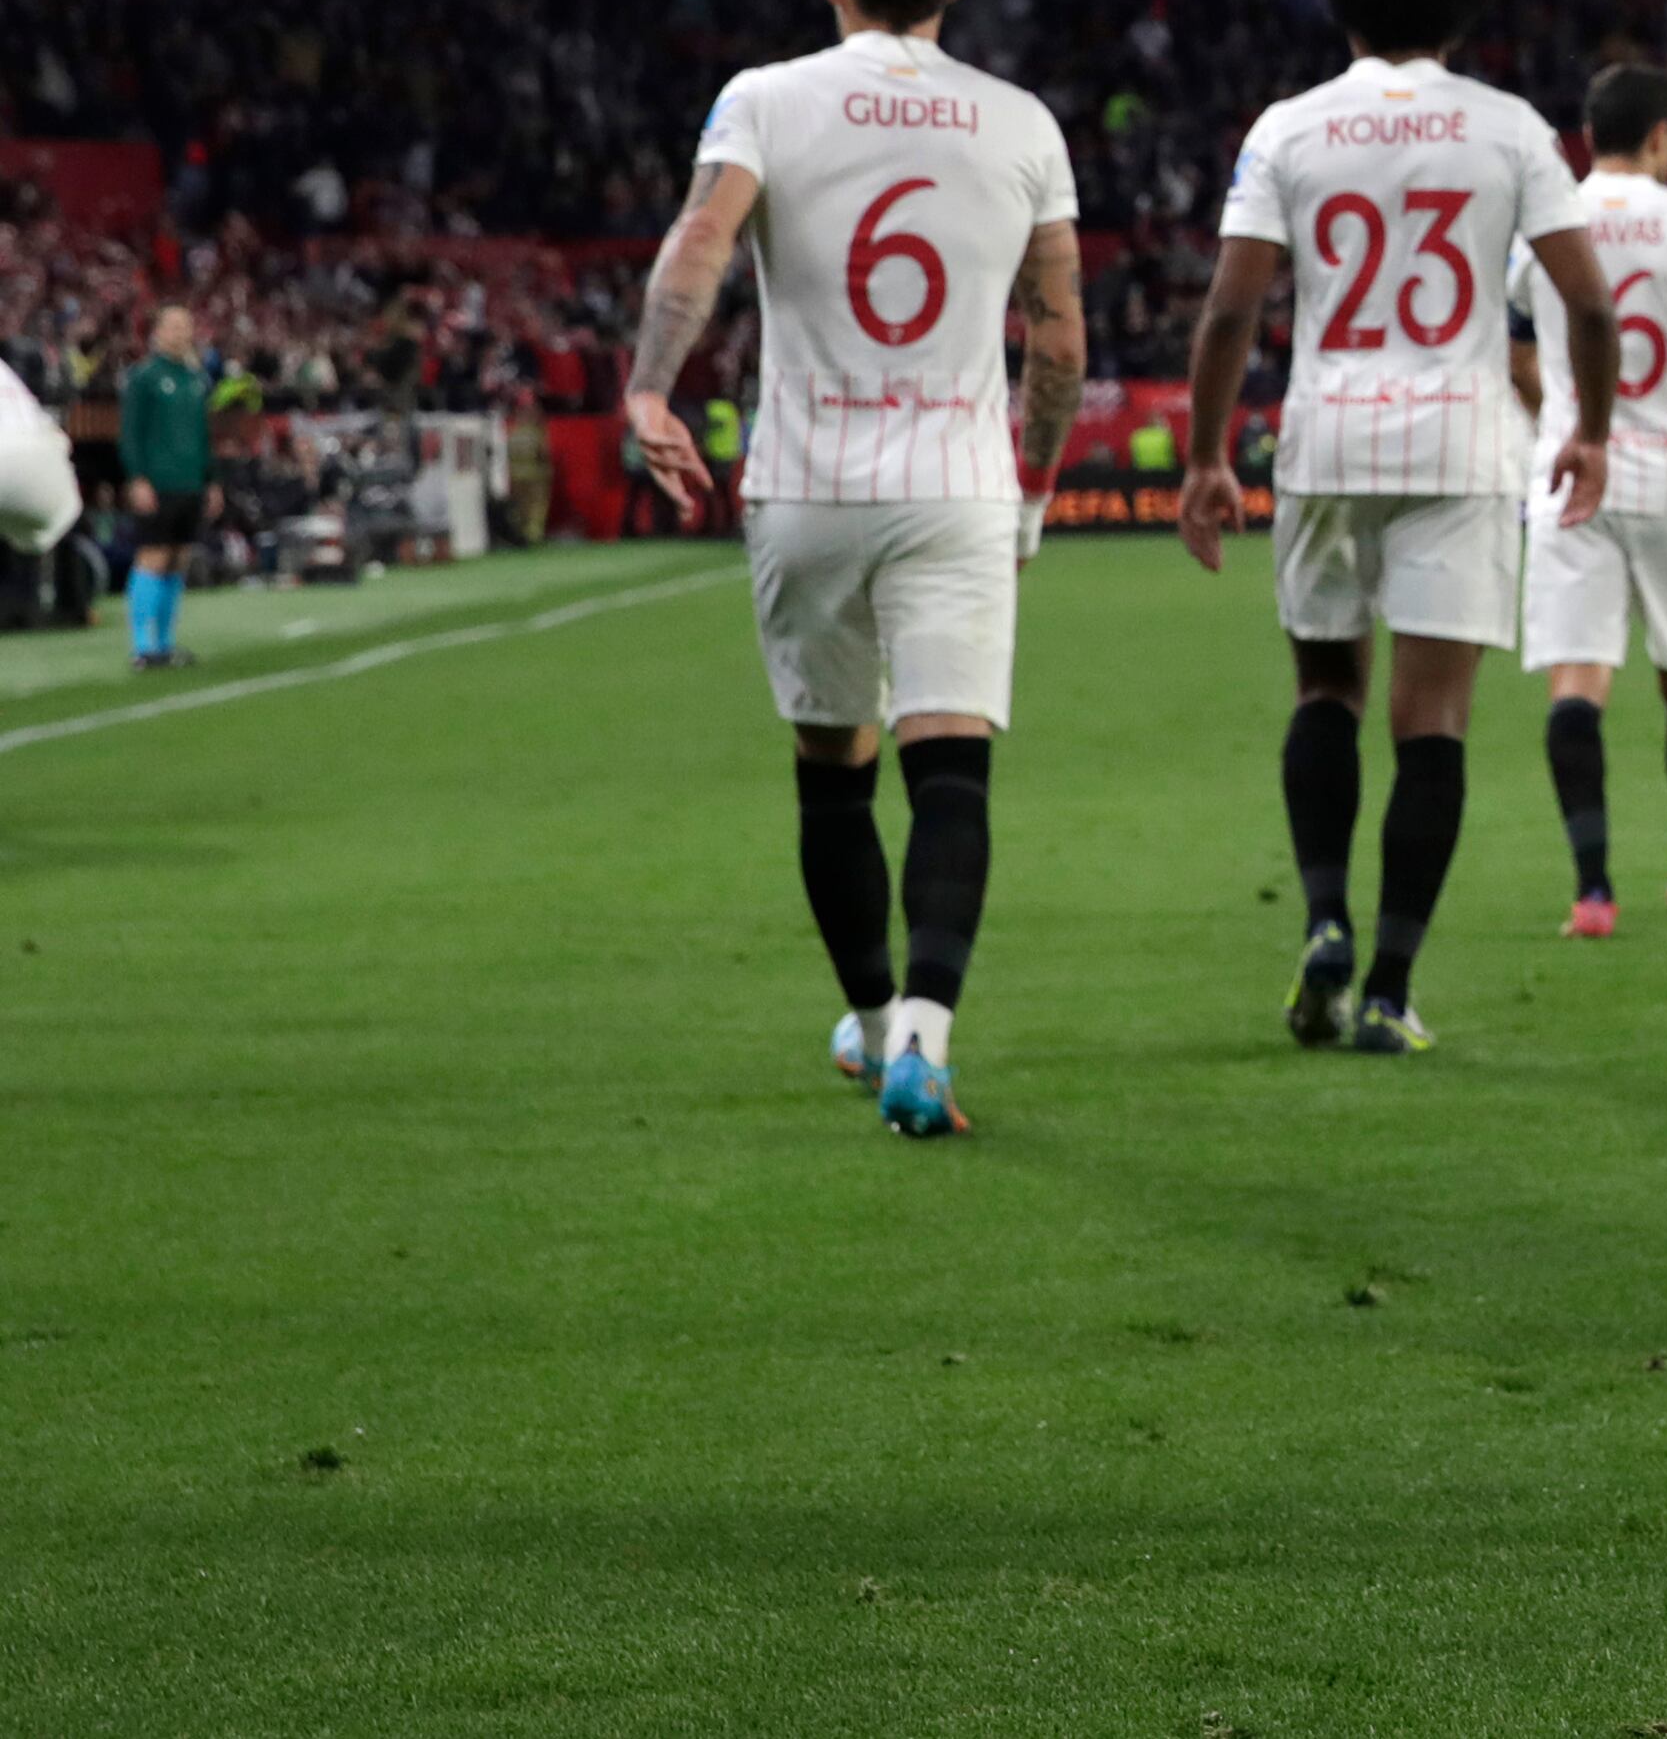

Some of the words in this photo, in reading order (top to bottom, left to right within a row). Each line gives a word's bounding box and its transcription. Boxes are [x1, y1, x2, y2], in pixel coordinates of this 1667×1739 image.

[843, 92, 979, 137] GUDELJ
[847, 176, 947, 348] 6
[1314, 189, 1477, 353] 23
